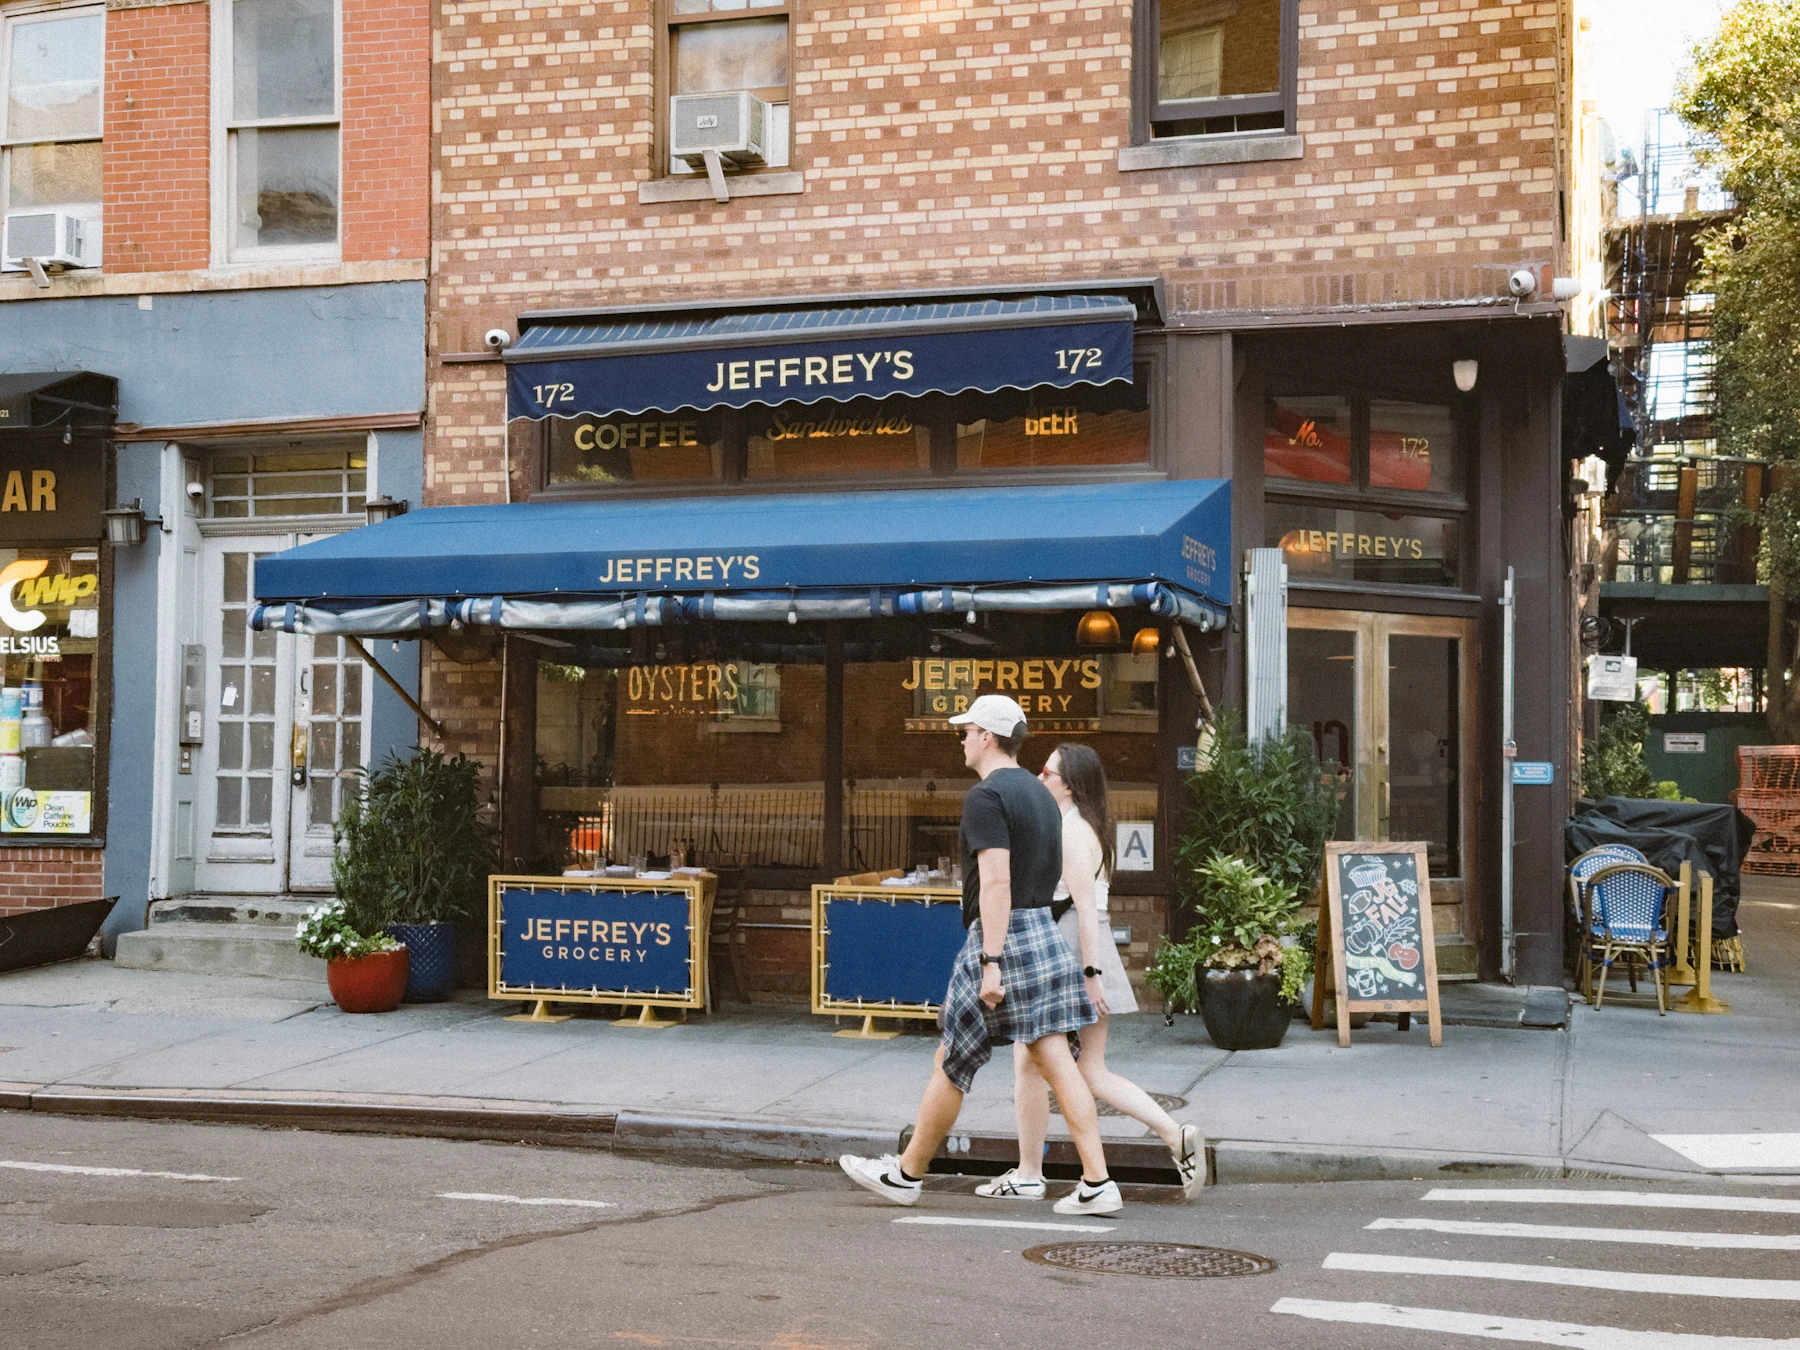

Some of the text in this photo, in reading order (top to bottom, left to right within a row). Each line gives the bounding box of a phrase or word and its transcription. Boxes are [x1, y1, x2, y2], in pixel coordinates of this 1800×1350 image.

[706, 350, 915, 392] JEFFREY'S
[1055, 348, 1102, 375] 172
[533, 383, 575, 409] 172
[765, 405, 913, 442] Sandwiches
[1024, 405, 1078, 436] BEER
[574, 421, 698, 451] COFFEE
[1400, 437, 1430, 459] 172
[1181, 534, 1217, 572] JEFFREY'S
[1293, 529, 1423, 560] JEFFREY'S
[599, 555, 760, 583] JEFFREY'S
[628, 663, 738, 701] OYSTERS
[901, 659, 1102, 690] JEFFREY'S
[932, 695, 1073, 713] GRERY
[43, 803, 66, 812] Clean
[43, 812, 75, 820] Caffeine
[43, 820, 76, 828] Pouches
[1123, 830, 1148, 858] A
[1372, 877, 1399, 904] JG
[1364, 892, 1409, 931] FALL
[520, 918, 672, 946] JEFFREY'S
[542, 945, 647, 963] GROCERY
